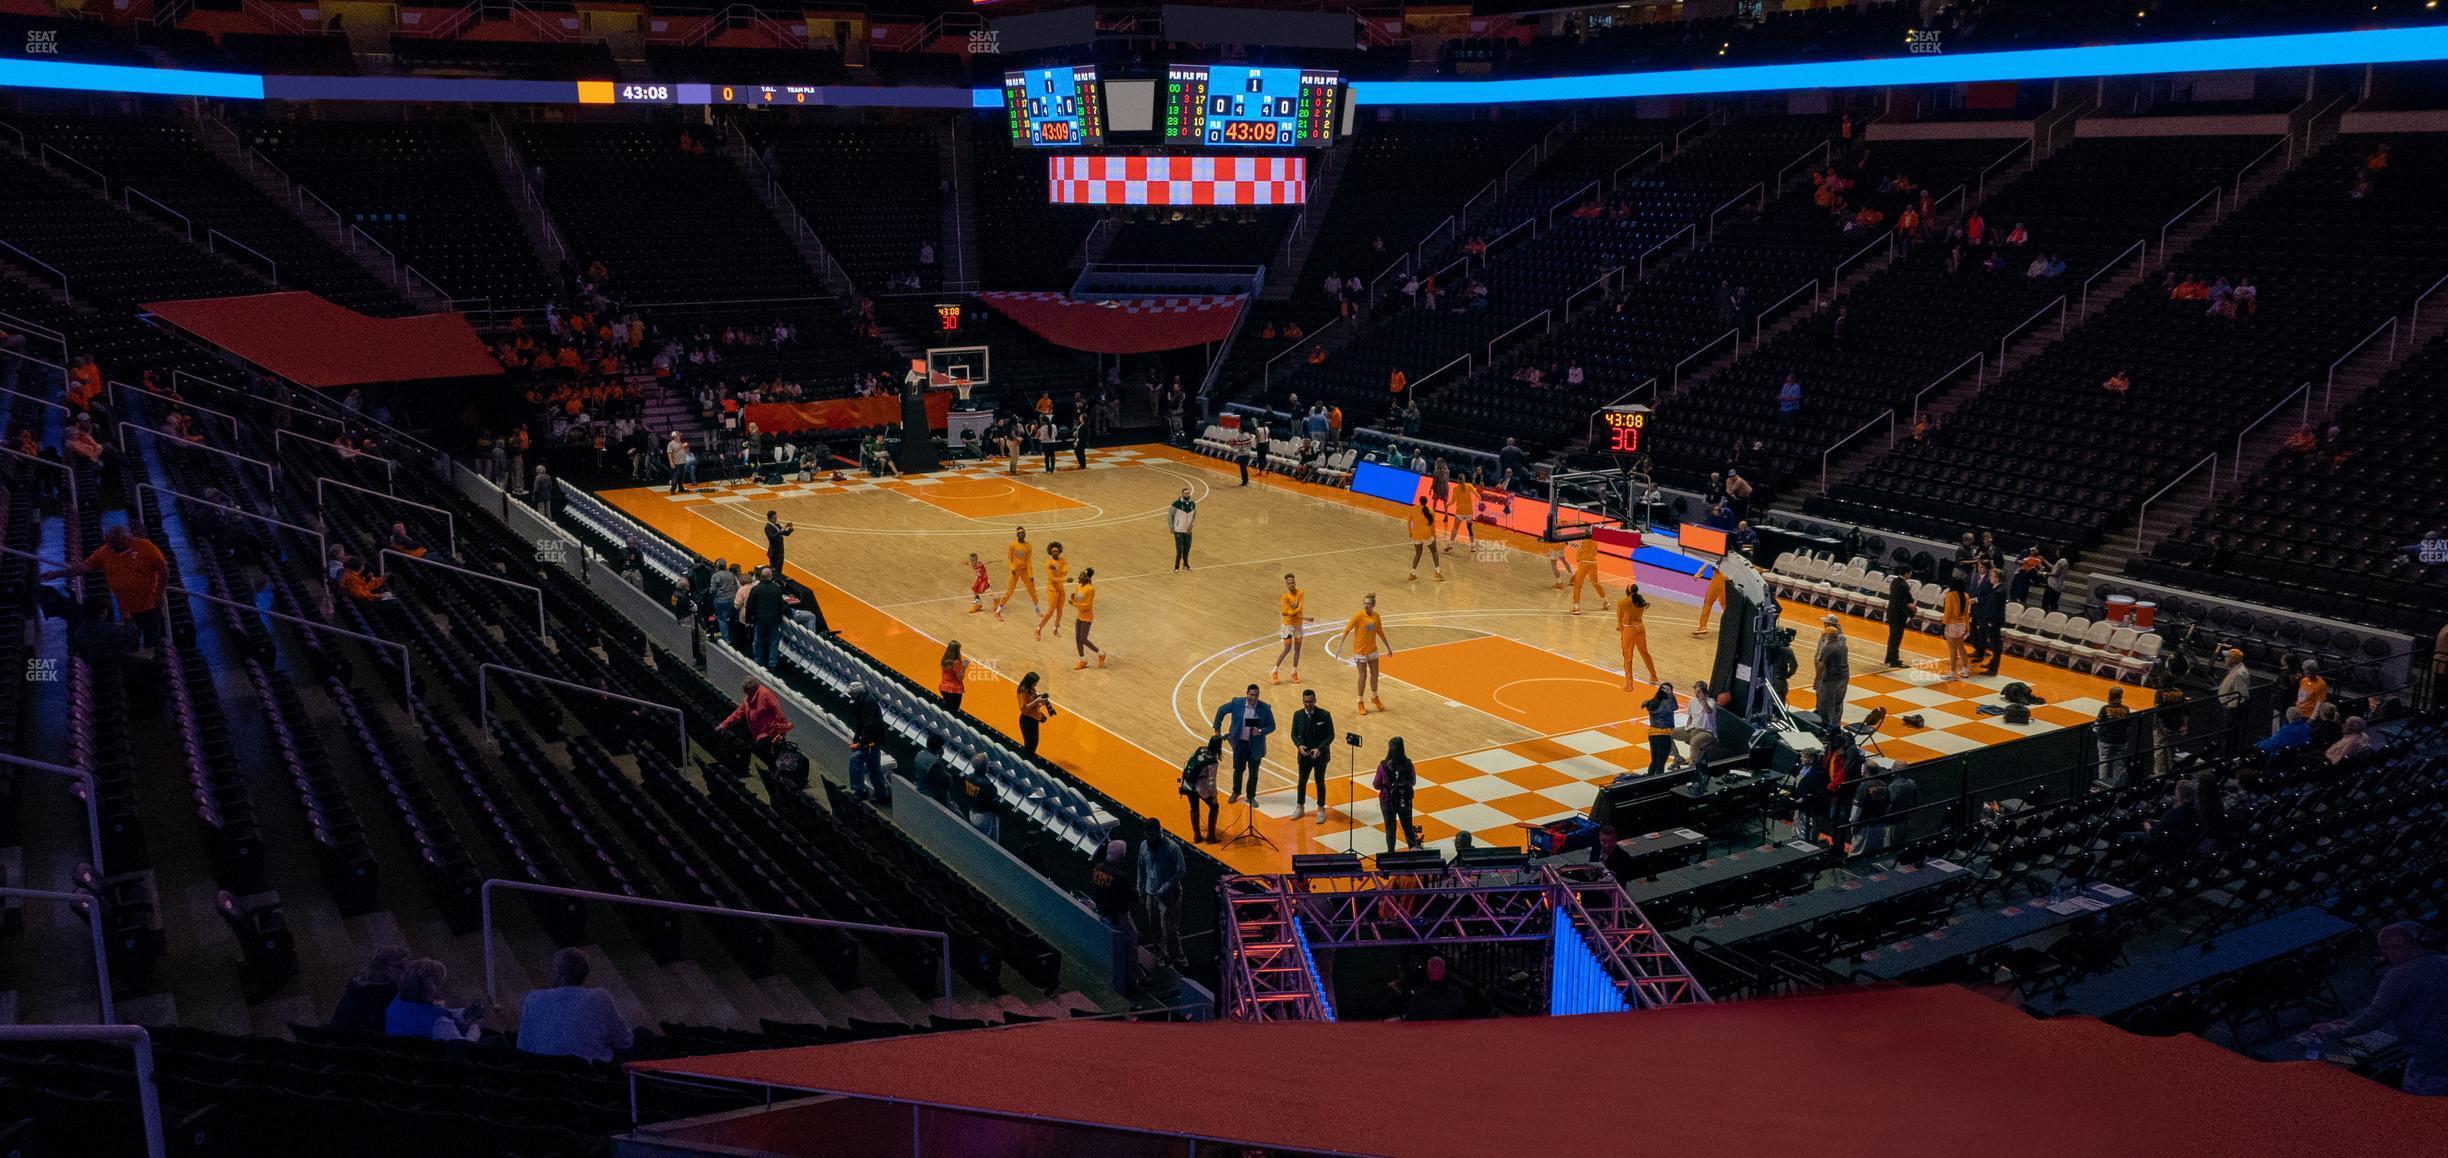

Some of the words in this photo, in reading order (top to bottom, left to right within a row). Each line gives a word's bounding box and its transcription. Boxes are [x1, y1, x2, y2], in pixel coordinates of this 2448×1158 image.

[1048, 81, 1052, 93] 1
[1090, 84, 1095, 93] 0
[1169, 84, 1180, 92] 00
[1186, 84, 1190, 92] 1
[1198, 84, 1204, 93] 9
[1252, 79, 1257, 92] 1
[623, 86, 668, 99] 43:08
[723, 87, 733, 101] 0
[764, 92, 772, 102] 4
[1303, 88, 1308, 97] 3
[1316, 88, 1322, 96] 0
[1327, 88, 1332, 97] 0
[797, 93, 804, 103] 0
[1091, 96, 1096, 104] 7
[1184, 95, 1190, 103] 3
[1195, 96, 1206, 104] 17
[1066, 100, 1072, 113] 0
[1217, 99, 1224, 112] 0
[1281, 101, 1288, 114] 0
[1300, 99, 1309, 107] 11
[1326, 99, 1332, 107] 7
[1033, 102, 1038, 114] 0
[1044, 107, 1048, 116] 4
[1058, 106, 1062, 115] 4
[1086, 106, 1091, 114] 2
[1169, 106, 1179, 114] 13
[1184, 106, 1188, 114] 1
[1196, 107, 1203, 115] 8
[1236, 106, 1242, 114] 4
[1263, 106, 1269, 115] 4
[1315, 109, 1320, 117] 2
[1325, 110, 1331, 118] 7
[1094, 117, 1098, 125] 2
[1194, 117, 1204, 126] 10
[1298, 120, 1307, 128] 21
[1324, 120, 1330, 128] 2
[1042, 122, 1068, 140] 43:09
[1096, 128, 1100, 136] 0
[1167, 128, 1178, 136] 33
[1182, 128, 1188, 136] 0
[1195, 128, 1201, 136] 0
[1226, 122, 1276, 140] 43:09
[1313, 130, 1318, 138] 0
[1035, 132, 1039, 141] 0
[1072, 131, 1076, 141] 0
[1211, 132, 1218, 140] 0
[1282, 132, 1288, 142] 0
[939, 307, 960, 316] 43:08
[943, 316, 957, 329] 30
[1606, 413, 1643, 428] 43:08
[1611, 428, 1636, 450] 30
